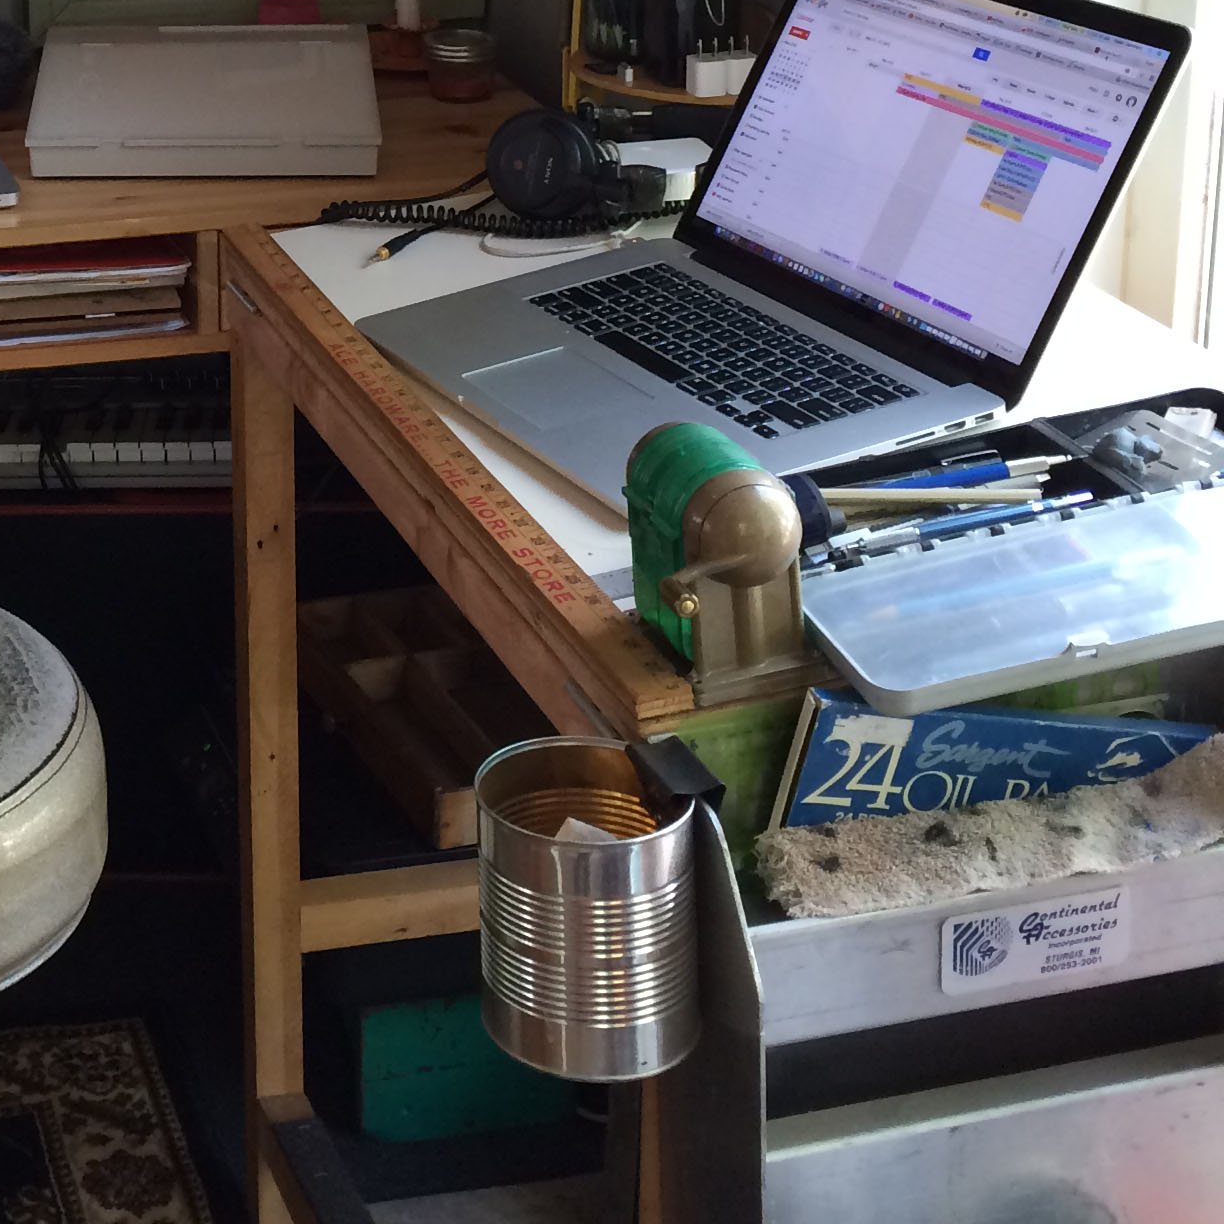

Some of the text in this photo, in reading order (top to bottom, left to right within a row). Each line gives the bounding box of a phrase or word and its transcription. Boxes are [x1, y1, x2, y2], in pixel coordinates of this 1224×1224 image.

[434, 460, 469, 489] THE
[466, 495, 517, 540] MORE
[512, 548, 577, 603] STORE
[801, 737, 907, 811] 24
[915, 720, 1071, 778] Sargent
[1019, 893, 1121, 935] Continental
[1022, 917, 1118, 946] Accessories
[1089, 946, 1101, 955] MI
